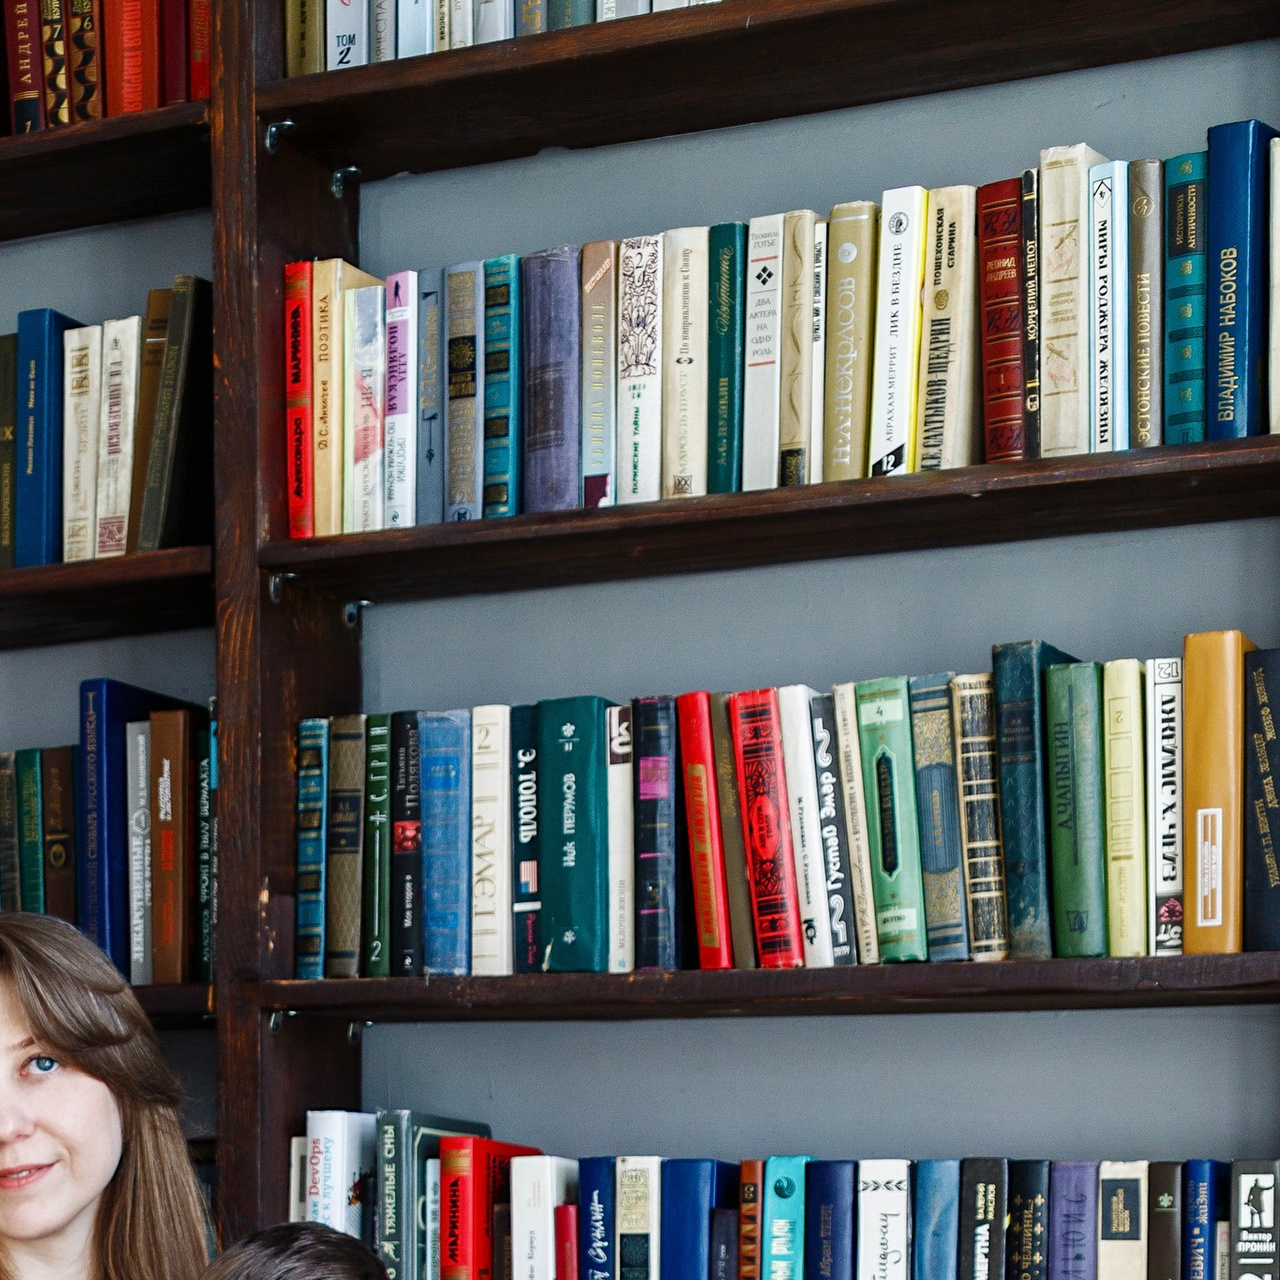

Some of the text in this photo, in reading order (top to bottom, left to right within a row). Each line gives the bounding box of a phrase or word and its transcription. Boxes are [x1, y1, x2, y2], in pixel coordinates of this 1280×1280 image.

[336, 34, 355, 47] ТОМ
[337, 48, 352, 64] 2
[947, 222, 956, 268] СТАРИНА
[1176, 194, 1184, 245] ИСТОРИКИ
[1187, 184, 1196, 248] АНТИЧНОСТИ
[681, 247, 693, 272] Свану
[933, 208, 944, 286] ПОШЕХОНСКАЯ
[986, 270, 1017, 282] АНДРЕЕВ
[988, 257, 1016, 270] ЛЕОНИД
[681, 282, 692, 340] направлению
[755, 298, 771, 307] ДВА
[890, 243, 902, 337] ЛИК В БЕЗДНЕ
[1025, 240, 1037, 340] КОРНЕЛИЙ НЕПОТ
[318, 295, 329, 362] ПОЭТИКА
[679, 343, 690, 354] По
[751, 335, 773, 344] ОДНУ
[752, 347, 773, 357] РОЛЬ
[1099, 219, 1109, 442] МИРЫ РОДЖЕРА ЖЕЛЯЗНЫ
[1137, 273, 1150, 442] ЭСТОНСКИЕ ПОВЕСТИ
[1218, 247, 1238, 421] ВЛАДИМИР НАБОКОВ
[388, 326, 398, 413] ПОЛЯНСКАЯ
[398, 352, 407, 382] АЛЛА
[590, 301, 604, 466] УБИЙЦА ПОНЕВОЛЕ
[886, 345, 897, 442] АБРАХАМ МЕРРИТ
[387, 422, 395, 434] ПО
[632, 407, 640, 494] ПАРИЖСКИЕ ТАЙНЫ
[678, 371, 688, 474] МАРСЕЛЬ ПРУСТ
[387, 470, 395, 501] НОЧАМ
[397, 437, 406, 482] ПРОГУЛКИ
[881, 454, 894, 470] 12
[1158, 662, 1179, 679] 12
[397, 747, 405, 790] Татьяна
[406, 729, 418, 807] Полякова
[1161, 694, 1176, 794] ДЖЕЙМС
[86, 713, 97, 859] СЛОВАРЬ РУССКОГО ЯЗЫКА
[518, 770, 536, 842] ТОПОЛЬ
[562, 773, 575, 834] ПЕРУМОВ
[817, 772, 842, 890] Густав Эмар
[1163, 824, 1176, 882] ЧЕЙЗ
[309, 1138, 321, 1196] DevOps
[323, 1137, 333, 1198] лучшему
[384, 1125, 396, 1235] ТЯЖЕЛЫЕ СНЫ
[447, 1178, 460, 1263] МАРИНИНА
[975, 1183, 986, 1220] ВАЛЕРИЙ
[986, 1183, 996, 1220] МАСЛОВ
[1199, 1182, 1208, 1224] жизни
[771, 1219, 795, 1255] РОМАН
[820, 1205, 832, 1276] Абрам ТЕРЦ
[1023, 1209, 1033, 1269] ЧЕЛЛИНИ
[1237, 1241, 1276, 1252] ПРОНИН
[1240, 1231, 1271, 1241] Виктор
